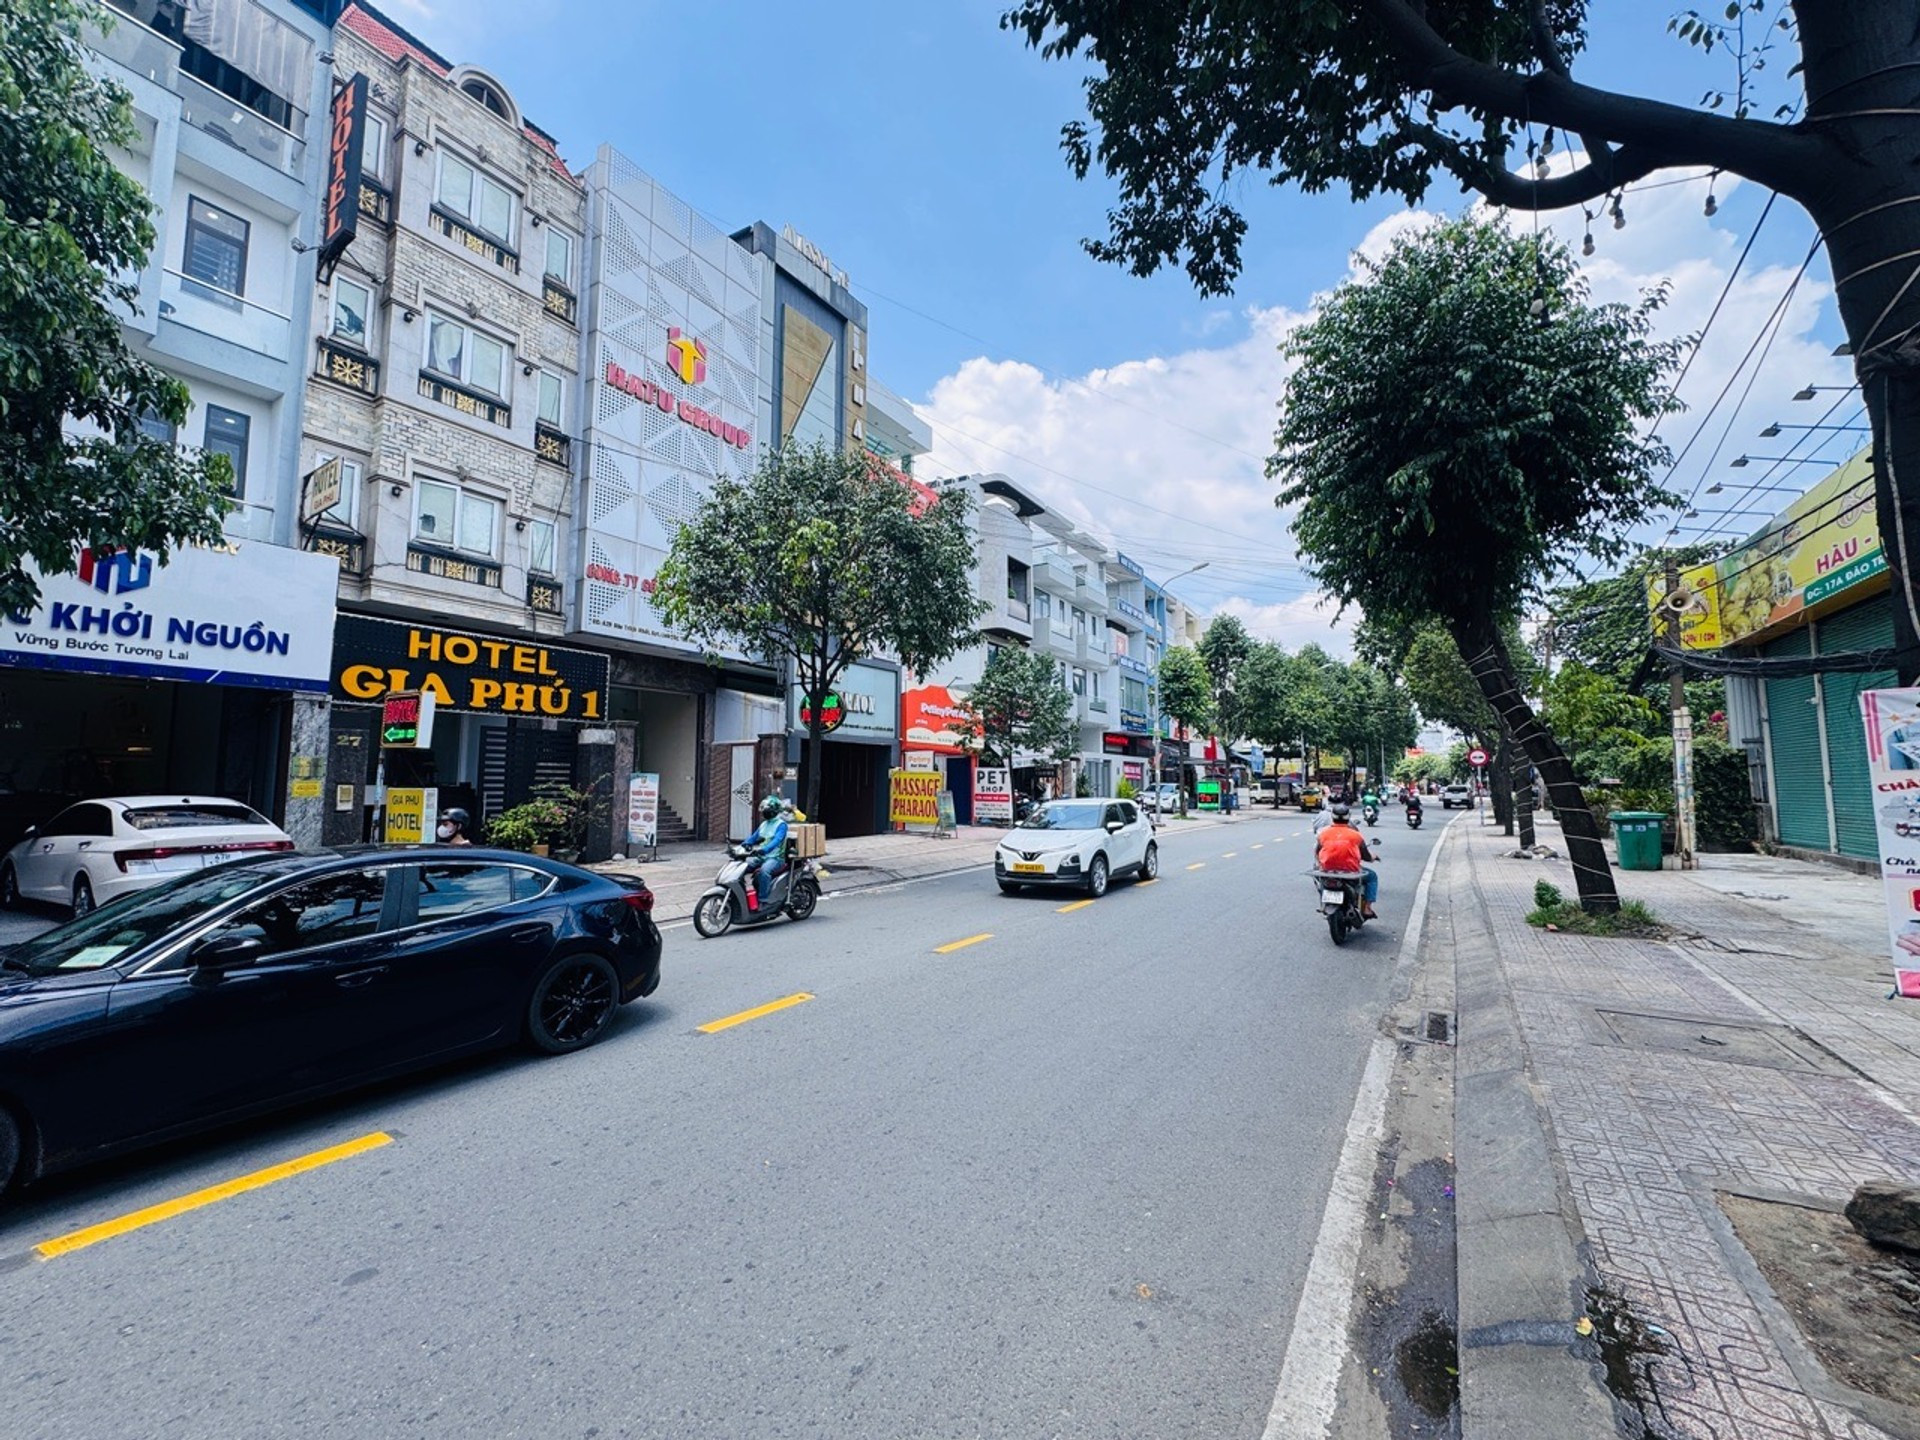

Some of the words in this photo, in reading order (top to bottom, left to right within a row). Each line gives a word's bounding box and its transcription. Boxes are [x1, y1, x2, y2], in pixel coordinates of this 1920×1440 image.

[326, 82, 356, 239] HOTEL
[678, 400, 751, 450] GROUP
[1825, 577, 1843, 591] 17A
[1845, 562, 1870, 581] ĐÀO
[51, 602, 153, 639] KHỞI
[167, 617, 290, 656] NGUỒN
[14, 632, 59, 649] Vững
[65, 636, 109, 653] Bước
[115, 642, 163, 660] Tương
[169, 648, 190, 661] Lai
[408, 630, 558, 676] HOTEL
[340, 664, 455, 705] GIA
[469, 678, 571, 715] PHÚ
[581, 690, 600, 718] 1
[385, 699, 418, 724] HOTEL
[336, 735, 363, 747] 27
[893, 777, 940, 797] MASSAGE
[977, 770, 1008, 784] PET
[391, 795, 403, 805] GIA
[893, 798, 939, 818] PHARAON
[387, 813, 422, 831] HOTEL
